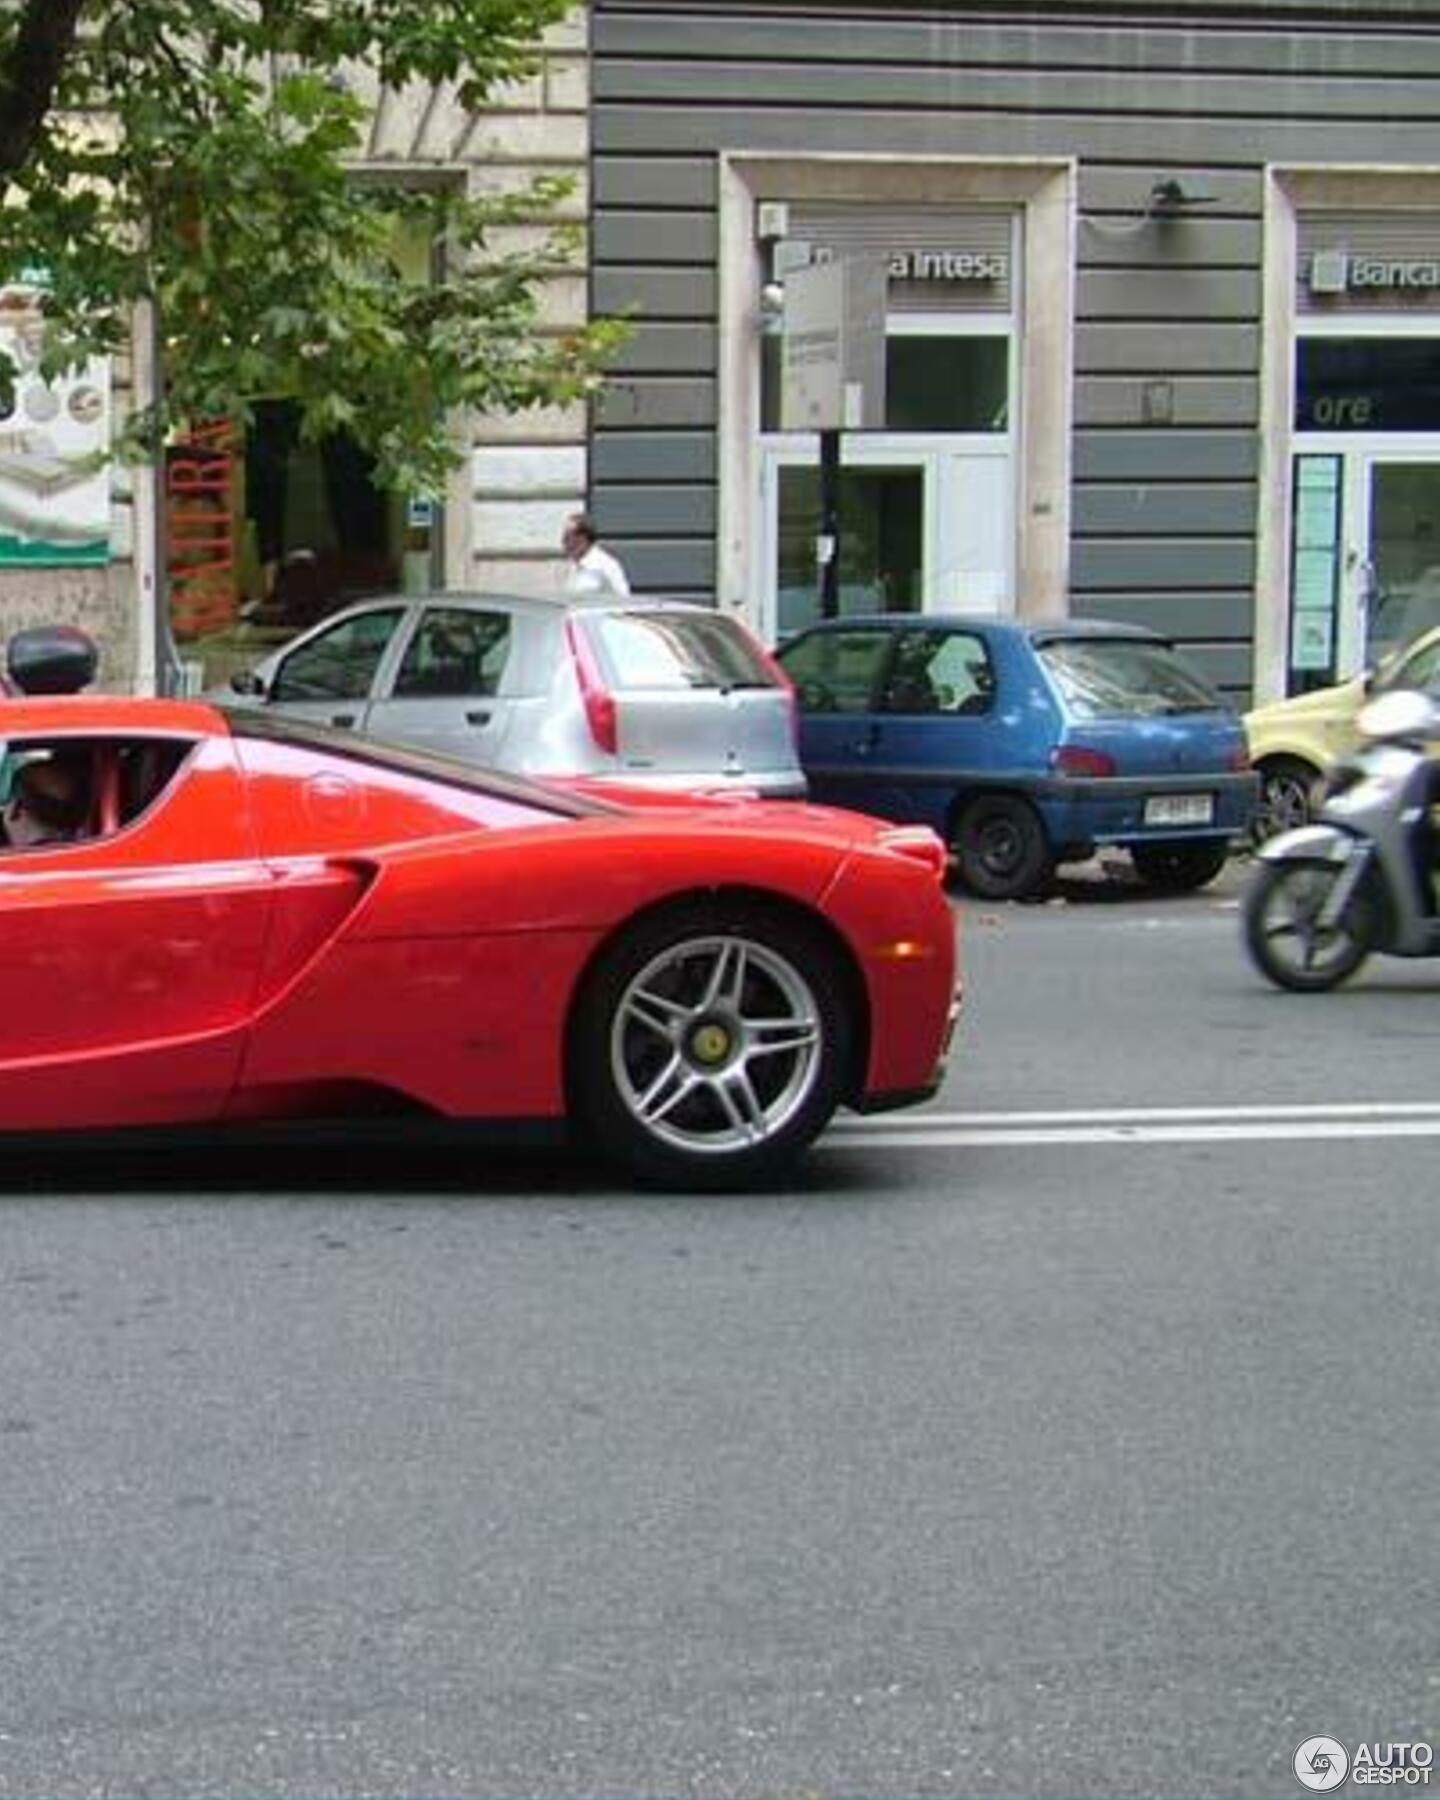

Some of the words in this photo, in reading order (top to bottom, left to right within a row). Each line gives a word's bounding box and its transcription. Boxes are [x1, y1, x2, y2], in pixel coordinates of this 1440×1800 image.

[913, 251, 1008, 279] Intesa
[1352, 259, 1439, 286] Banca
[1313, 396, 1372, 425] ore
